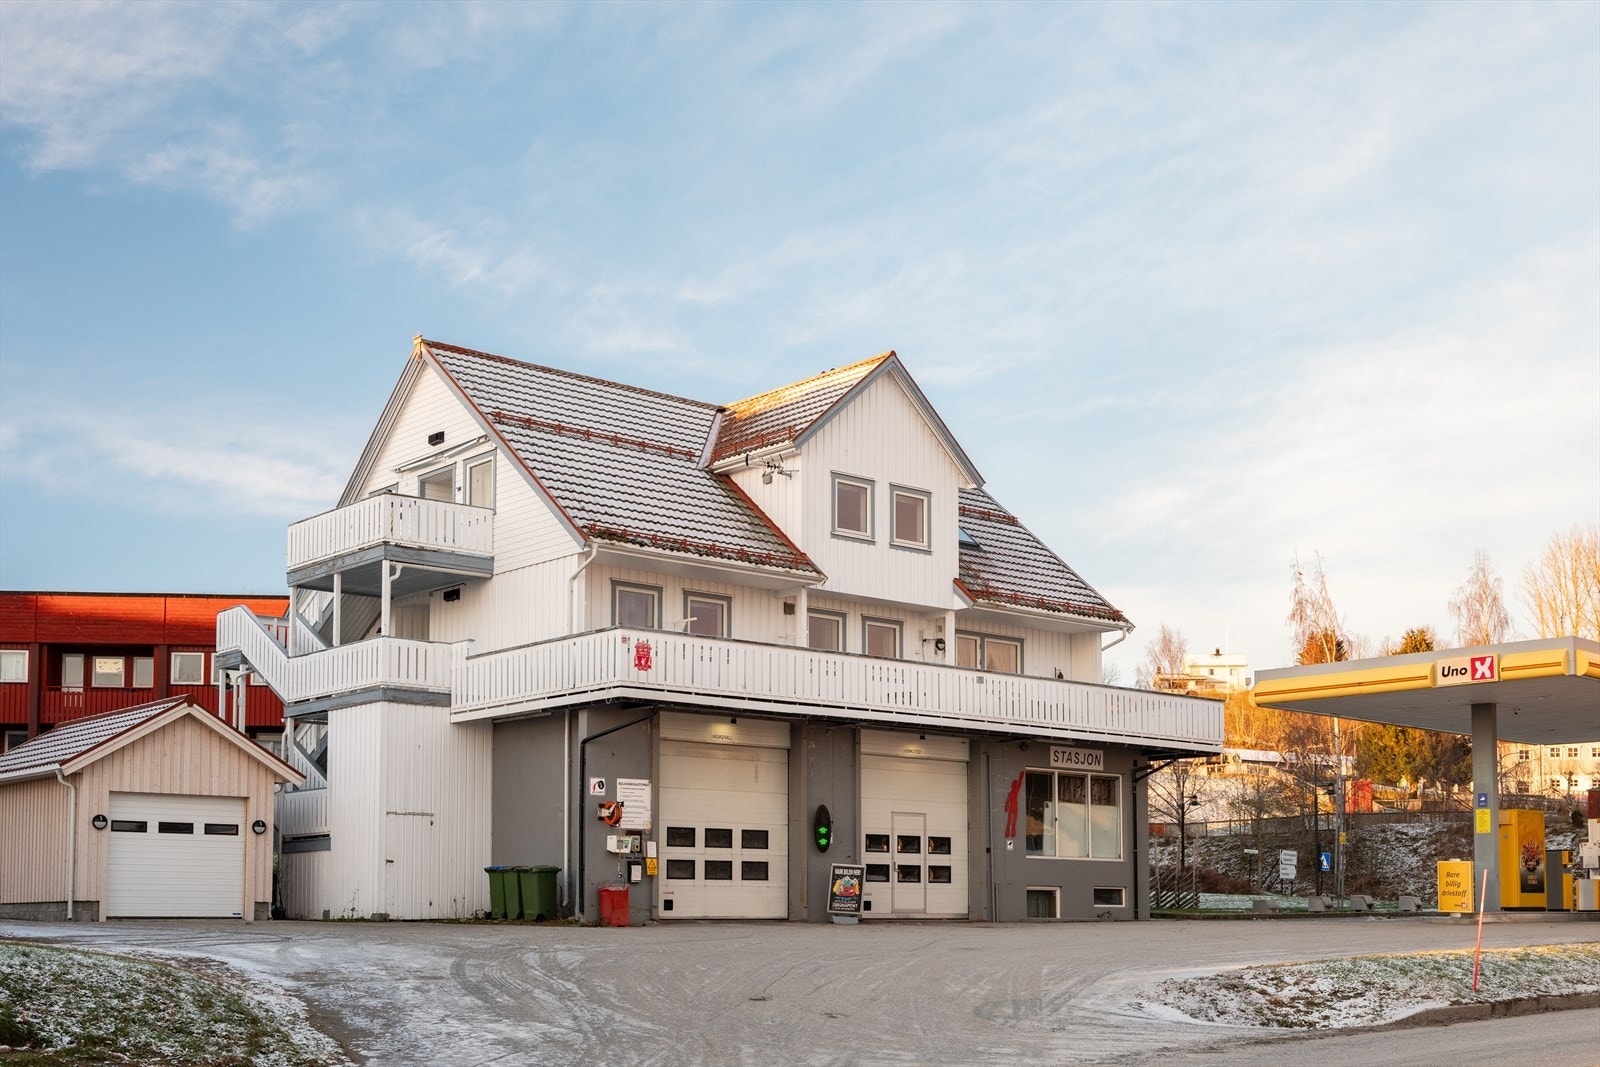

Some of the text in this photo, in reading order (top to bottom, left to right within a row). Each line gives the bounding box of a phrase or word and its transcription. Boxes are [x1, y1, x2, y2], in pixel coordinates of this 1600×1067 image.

[1441, 657, 1493, 679] Uno X
[1053, 750, 1102, 766] STASJON
[1441, 890, 1467, 898] drivstoff
